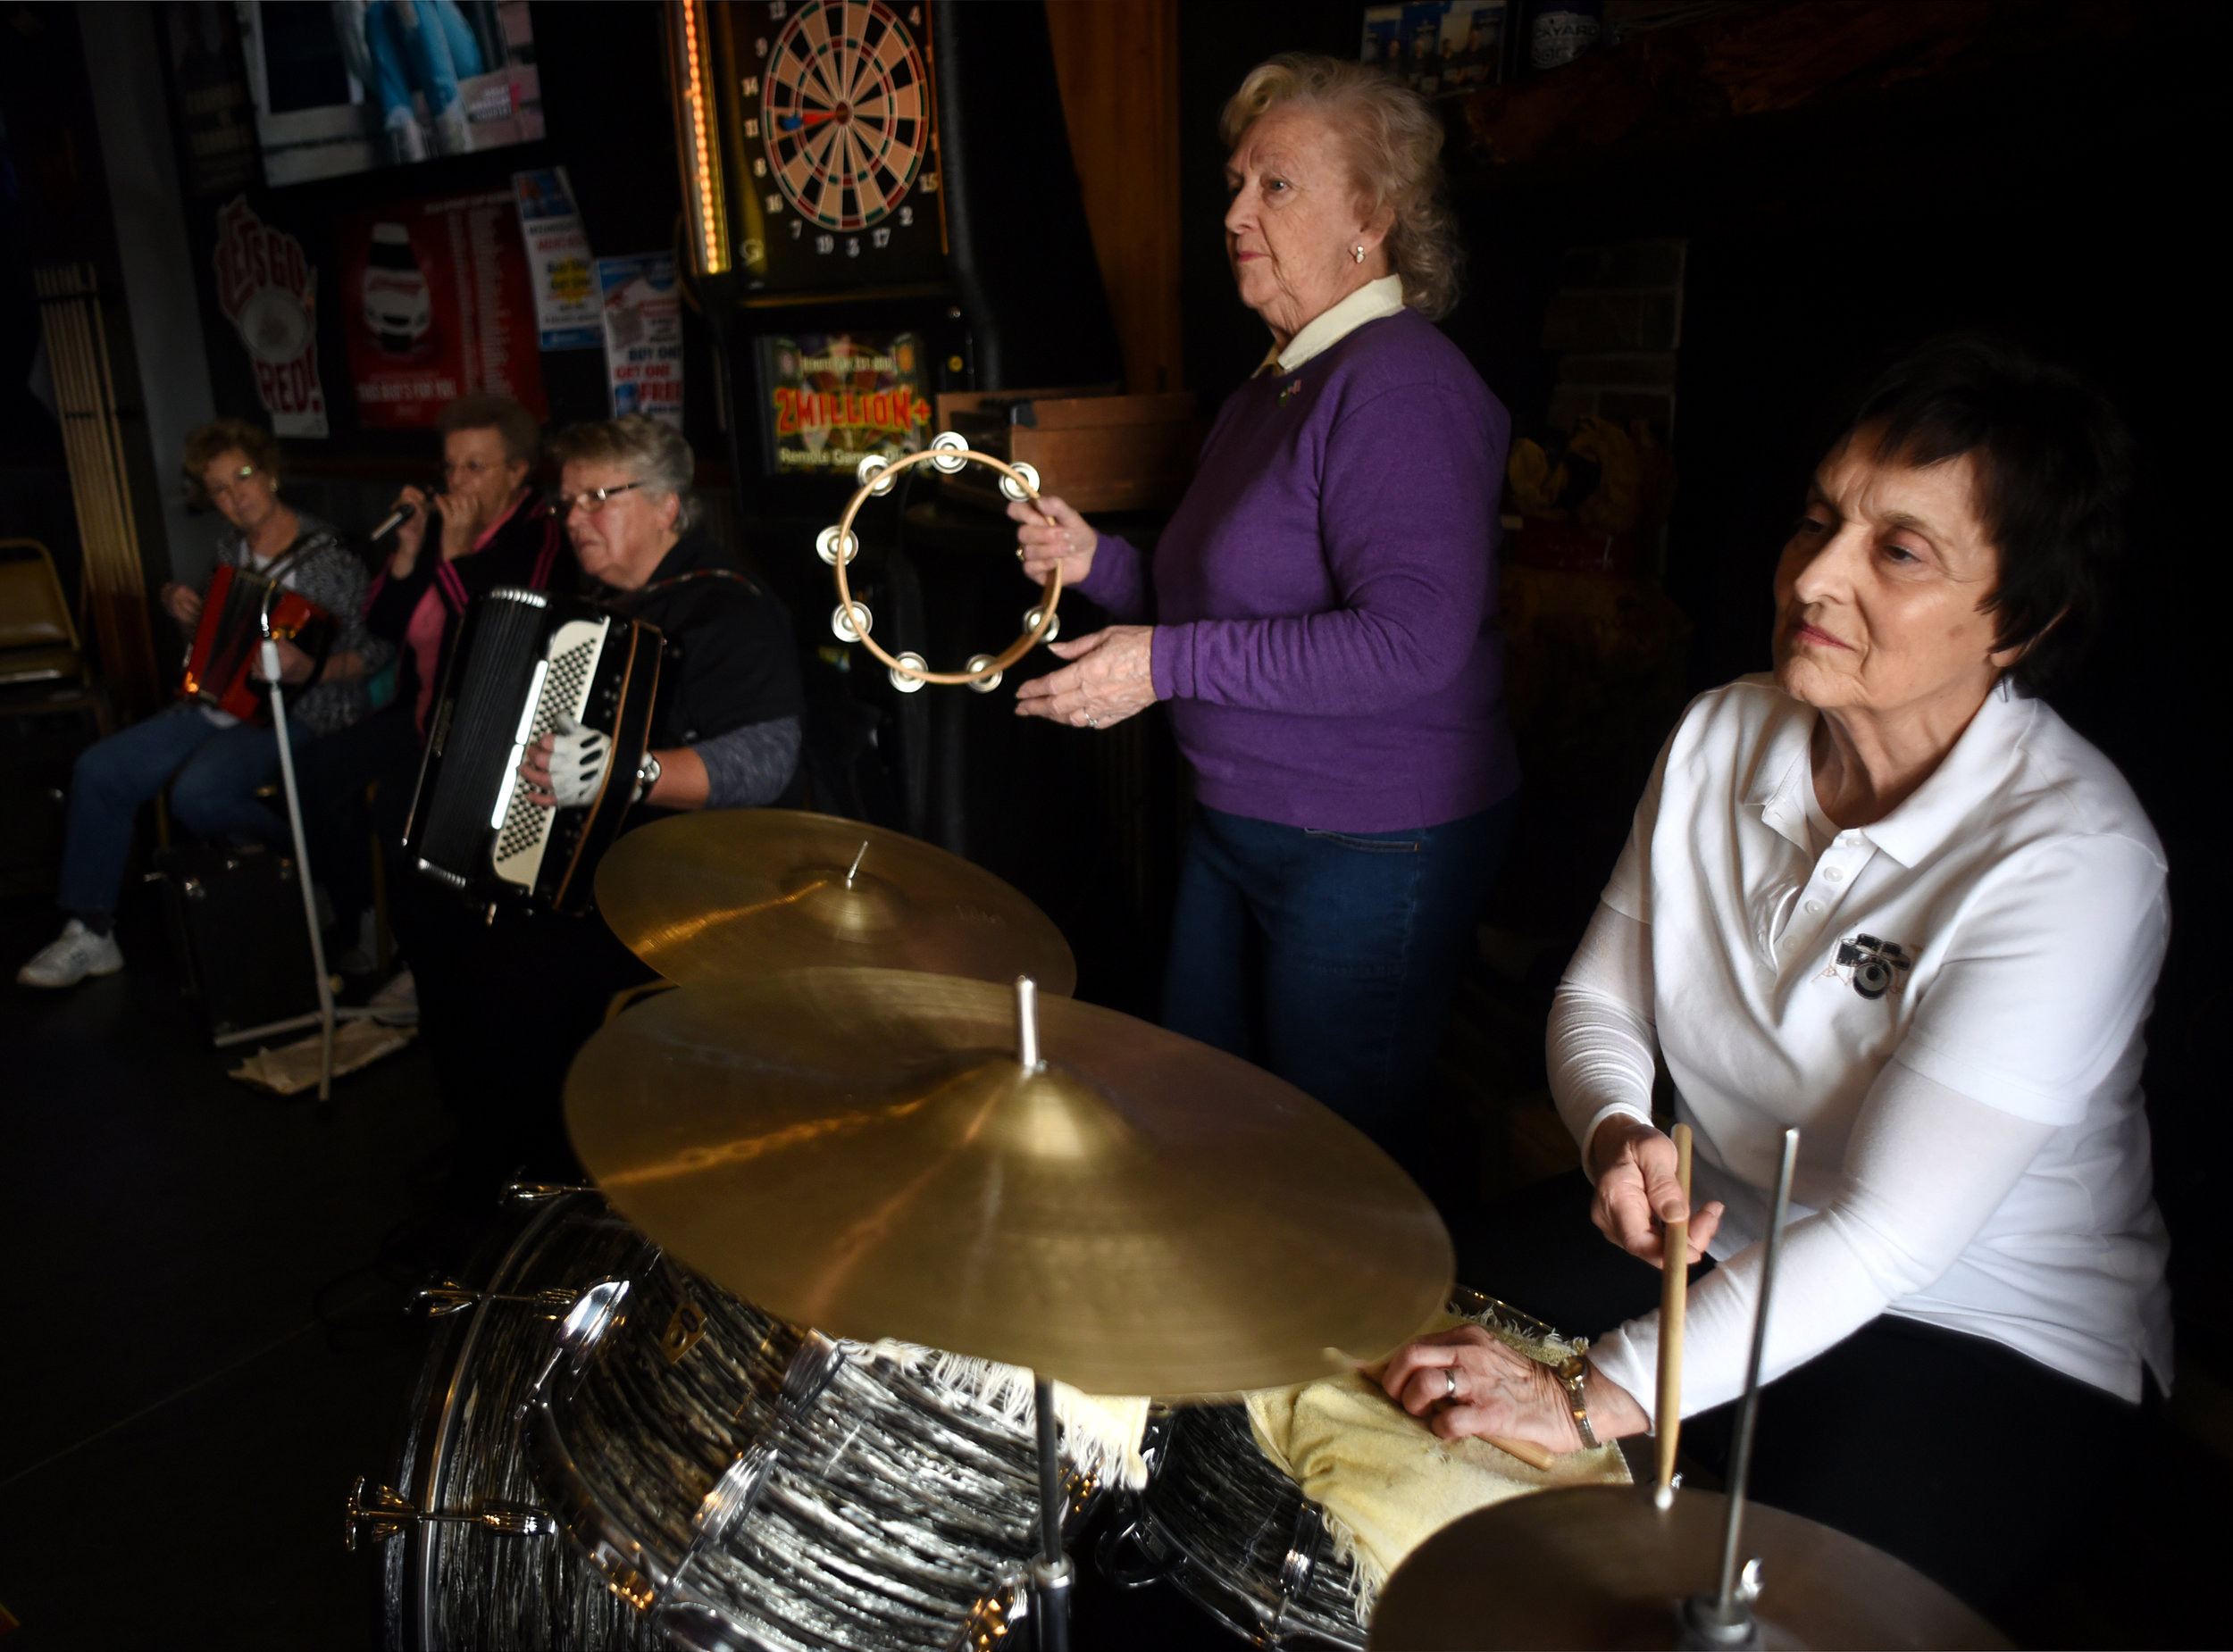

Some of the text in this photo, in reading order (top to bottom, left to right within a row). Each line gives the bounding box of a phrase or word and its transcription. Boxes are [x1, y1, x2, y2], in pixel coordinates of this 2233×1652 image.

[908, 5, 922, 27] 4
[755, 38, 768, 58] 9
[742, 76, 759, 97] 14
[744, 118, 759, 139] 11
[754, 157, 767, 178] 8
[899, 205, 913, 227] 2
[790, 219, 802, 240] 7
[872, 226, 891, 248] 17
[269, 228, 307, 299] GO
[630, 347, 653, 362] BUY
[258, 343, 322, 413] RED!
[616, 365, 640, 379] GET
